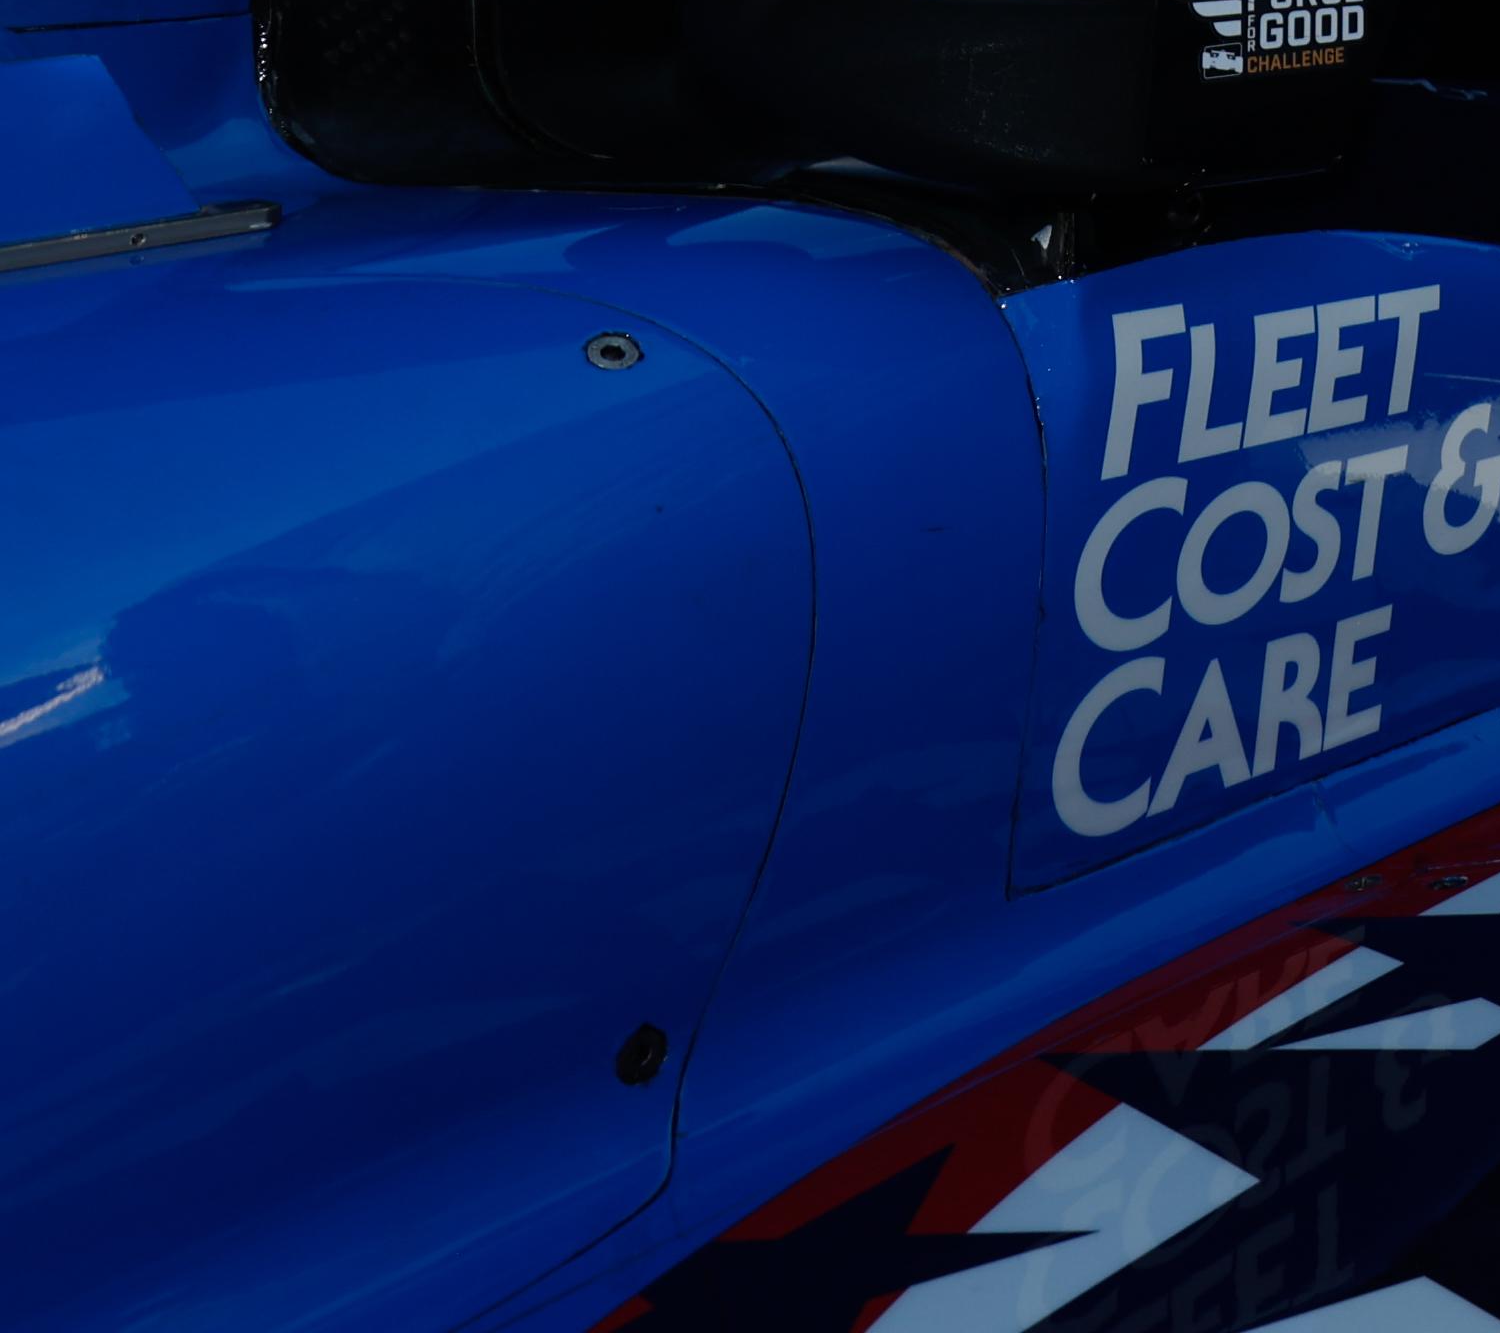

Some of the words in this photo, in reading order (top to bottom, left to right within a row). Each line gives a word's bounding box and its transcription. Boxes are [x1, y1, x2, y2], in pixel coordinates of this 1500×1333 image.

[1247, 46, 1345, 73] CHALLENGE
[1260, 4, 1365, 50] GOOD
[1100, 284, 1441, 481] FLEET
[1074, 444, 1409, 652] COST
[1052, 604, 1394, 837] CARE
